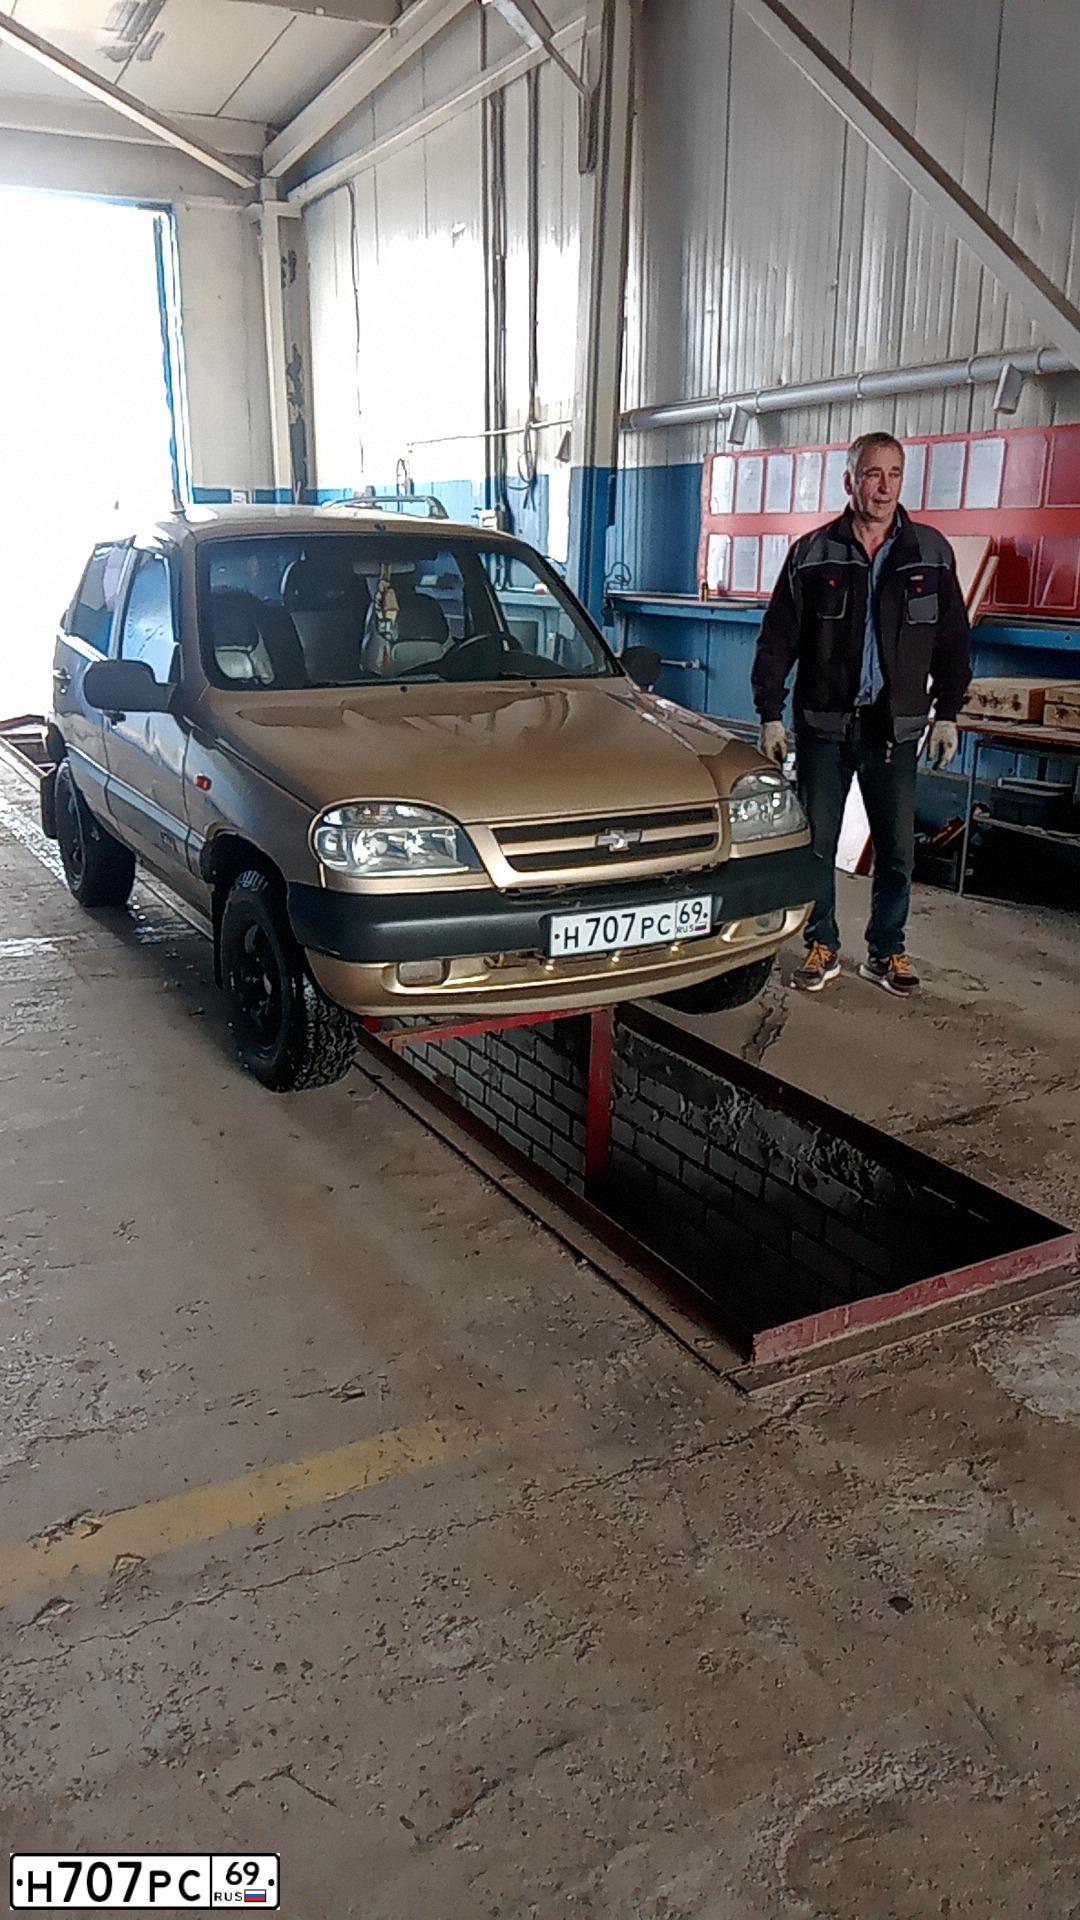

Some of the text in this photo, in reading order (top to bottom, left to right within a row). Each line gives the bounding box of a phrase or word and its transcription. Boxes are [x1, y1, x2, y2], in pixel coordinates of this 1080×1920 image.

[563, 901, 703, 950] Н707РС 69
[676, 924, 694, 934] RUS
